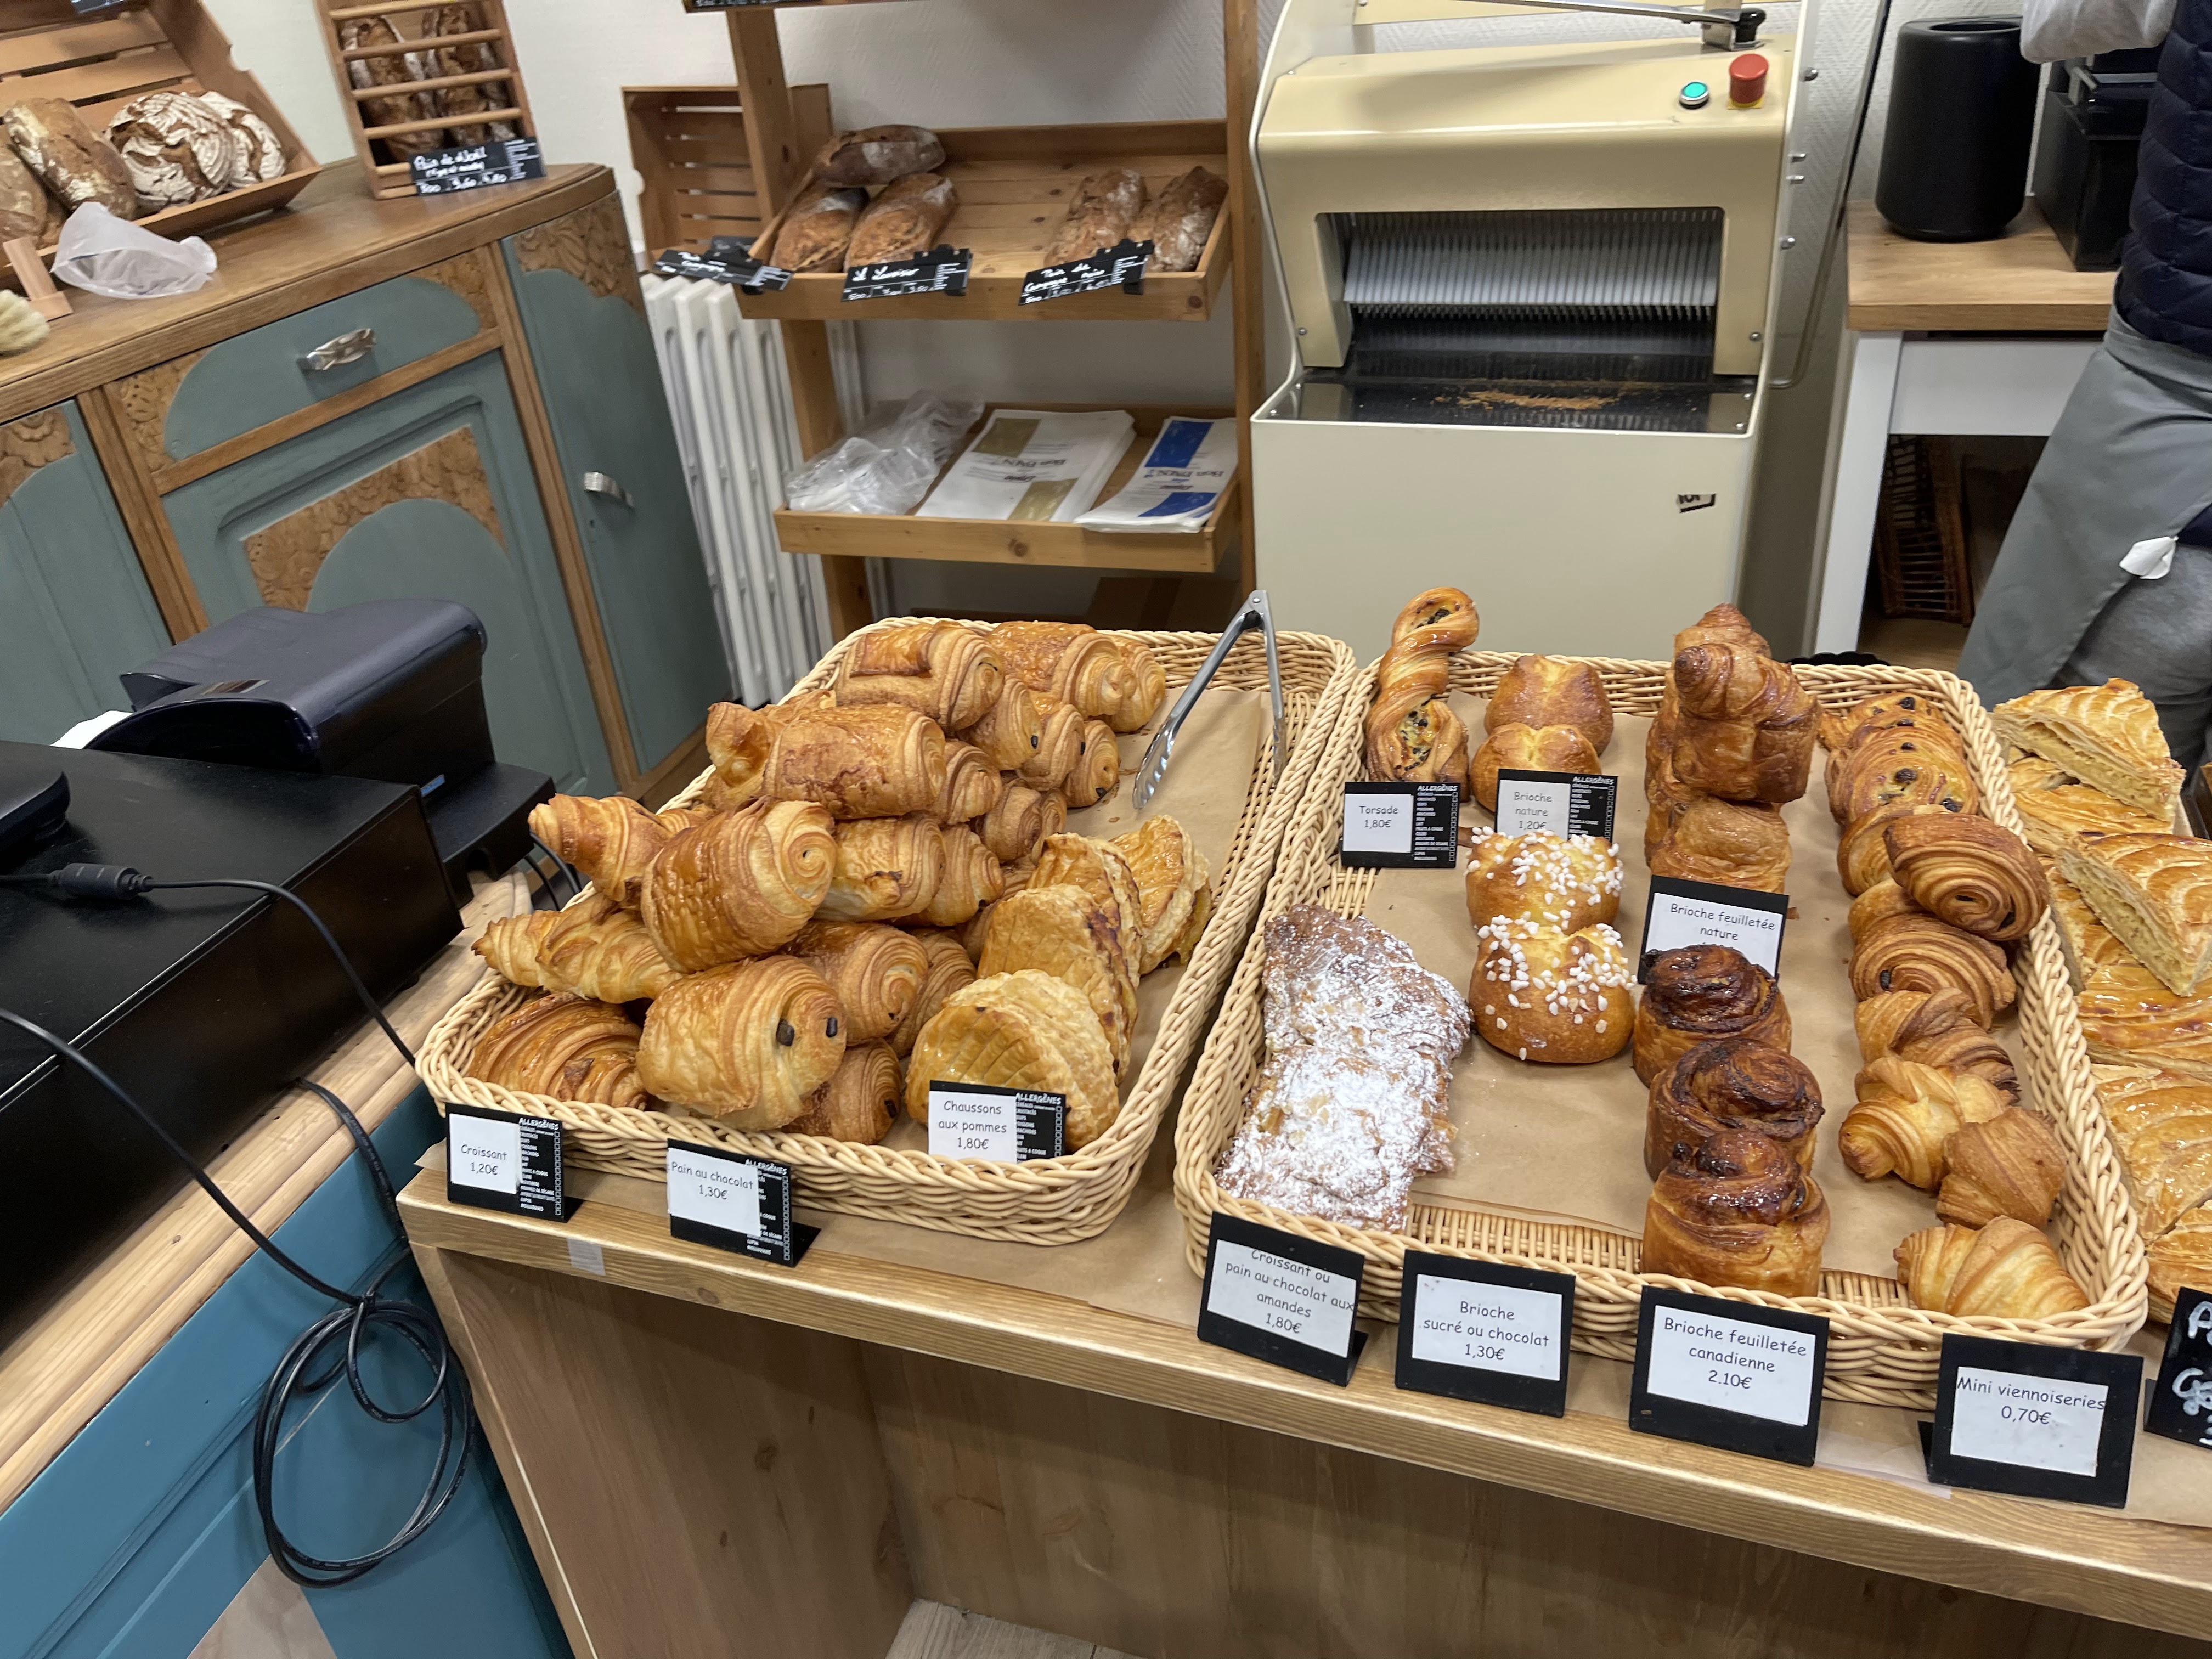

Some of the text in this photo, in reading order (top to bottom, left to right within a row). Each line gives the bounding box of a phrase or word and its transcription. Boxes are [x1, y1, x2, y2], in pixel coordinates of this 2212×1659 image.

[1514, 791, 1553, 803] Brioche
[1358, 805, 1399, 815] Torsade
[1515, 808, 1549, 816] nature
[1364, 819, 1392, 830] 1,80€
[1519, 820, 1547, 831] 1,20€
[1671, 903, 1775, 930] Brioche feuilletée
[1700, 926, 1739, 940] nature
[1015, 1092, 1062, 1105] ALLERGÈNES
[943, 1101, 1002, 1115] Chaussons
[939, 1121, 1007, 1133] aux pommes
[957, 1137, 989, 1150] 1,80€
[461, 1144, 507, 1161] Croissant
[470, 1162, 499, 1175] 1,20€
[672, 1161, 692, 1176] Pain
[695, 1170, 707, 1180] au
[710, 1171, 754, 1190] chocolat
[699, 1184, 728, 1200] 1,30€
[1251, 1249, 1330, 1283] Croissant ou
[1226, 1262, 1355, 1312] pain au chocolat aux
[1257, 1293, 1312, 1318] amandes
[1460, 1301, 1515, 1321] Brioche
[1266, 1313, 1302, 1334] 1,80€
[1423, 1318, 1550, 1347] sucré ou chocolat
[1664, 1317, 1807, 1356] Brioche feuilletée
[1465, 1344, 1505, 1361] 1,30€
[1689, 1347, 1776, 1373] canadienne
[1708, 1370, 1752, 1390] 2.10€
[1956, 1376, 2106, 1410] Mini viennoiseries
[2001, 1406, 2052, 1425] 0,70€
